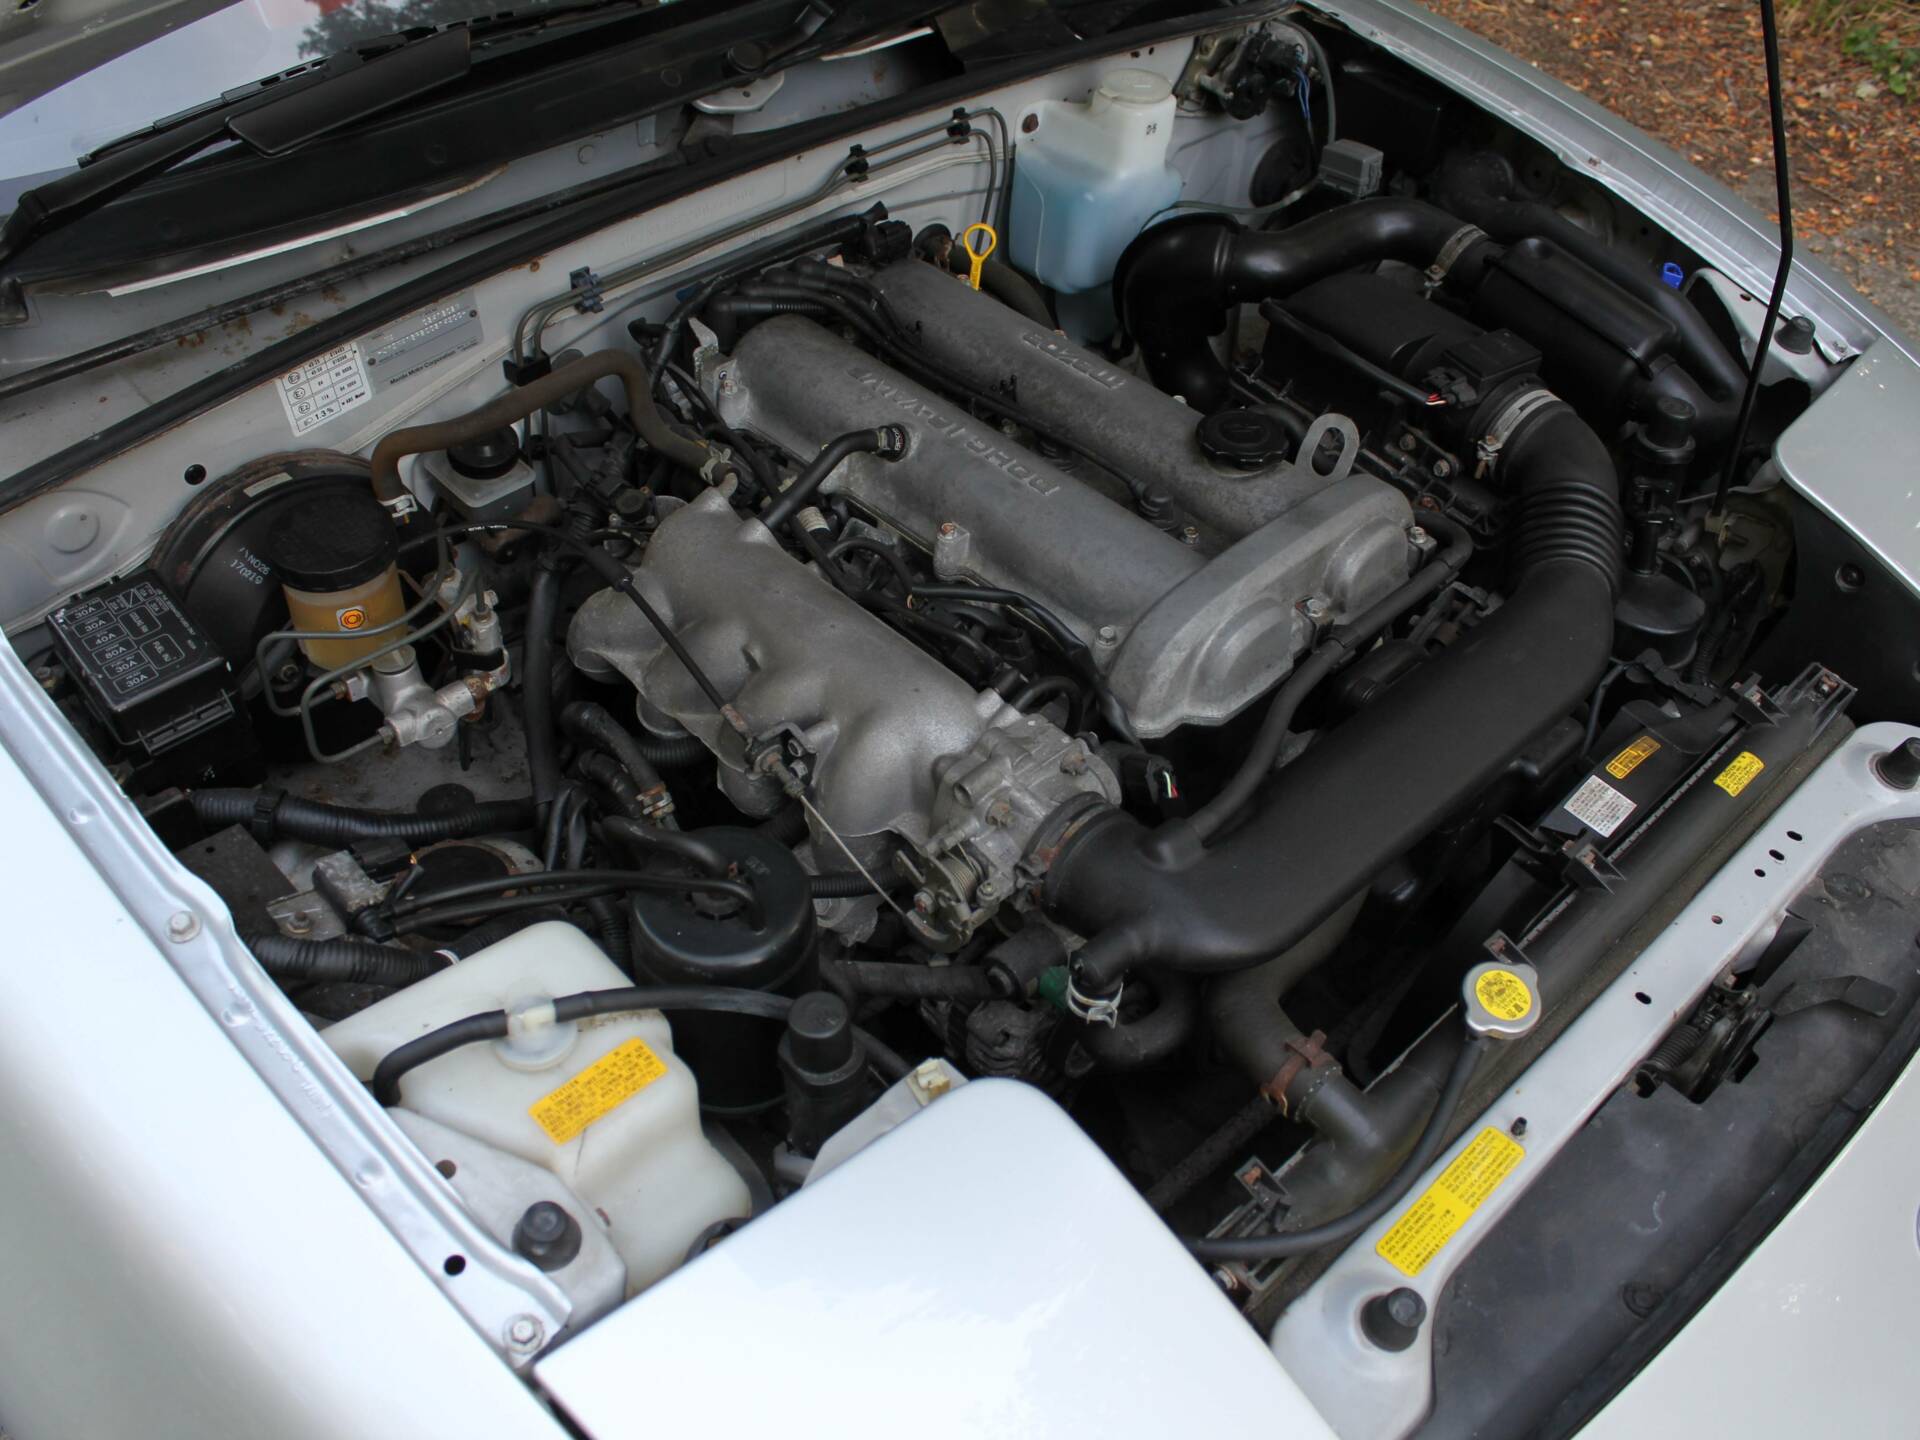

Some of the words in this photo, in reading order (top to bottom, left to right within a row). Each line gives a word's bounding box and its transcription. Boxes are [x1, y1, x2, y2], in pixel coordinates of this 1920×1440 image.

[75, 605, 96, 618] 30A
[84, 619, 107, 632] 30A
[95, 632, 116, 645] 40A
[115, 660, 138, 672] 30A
[126, 674, 148, 687] 30A
